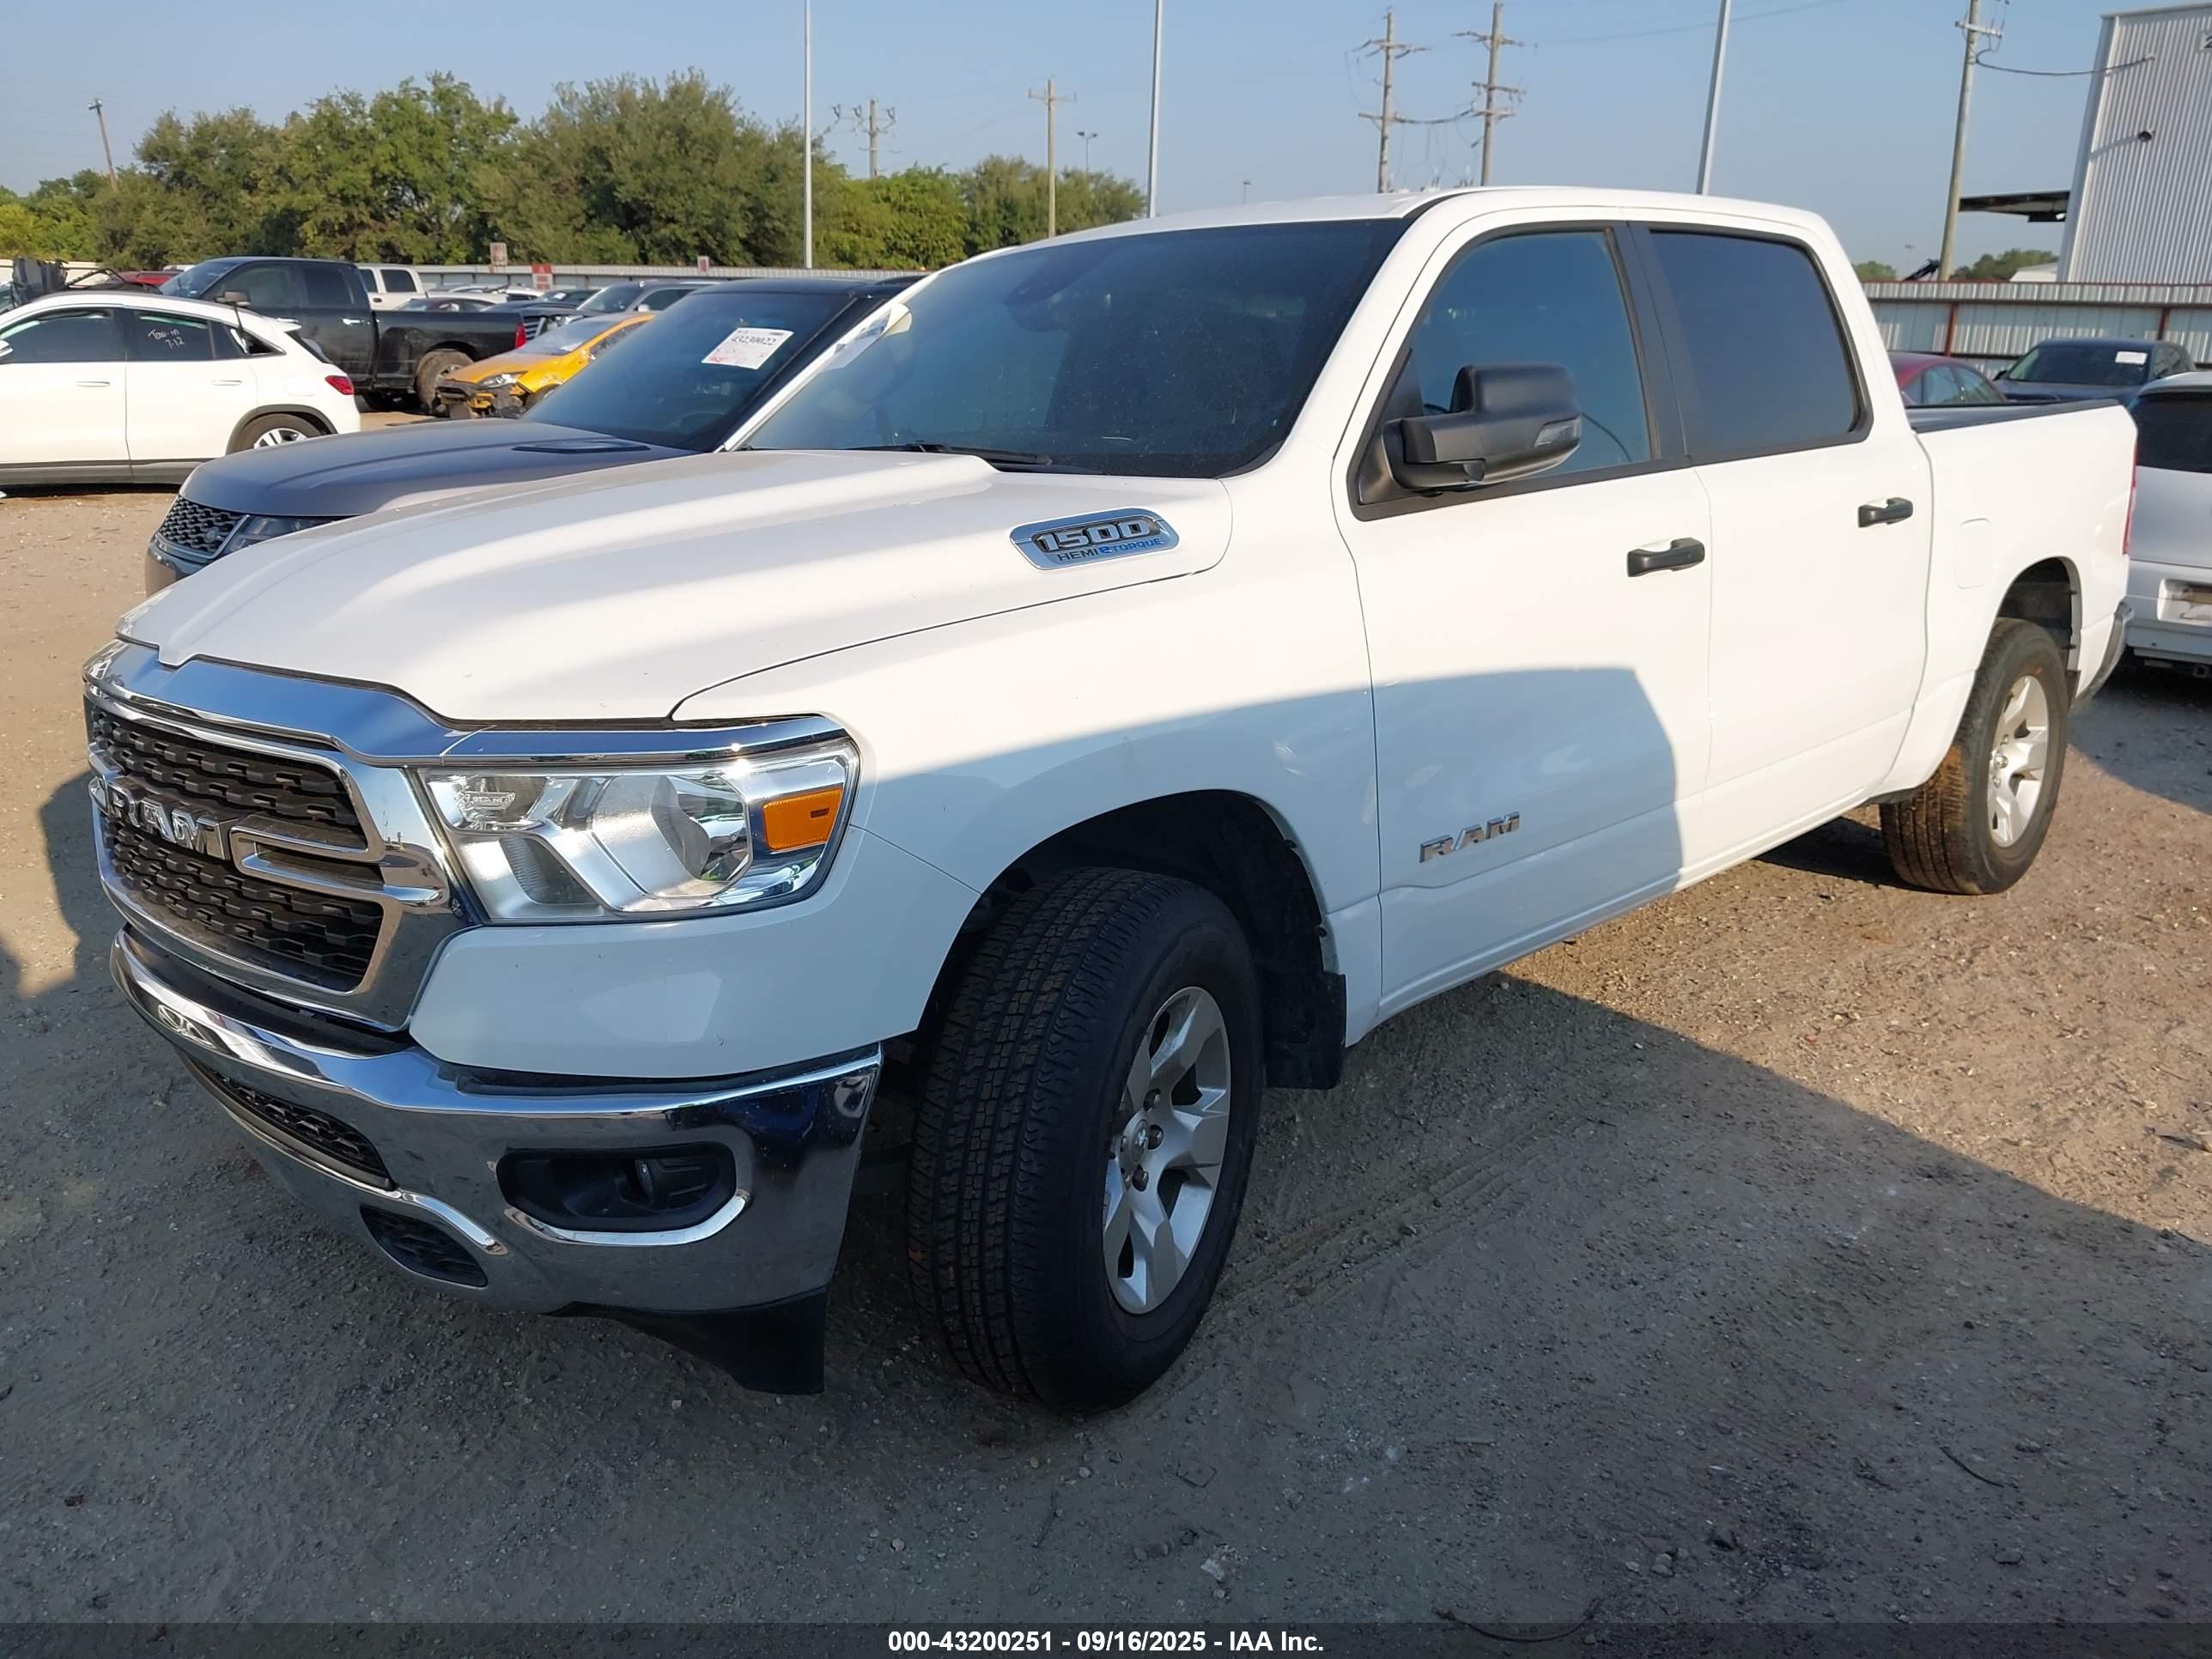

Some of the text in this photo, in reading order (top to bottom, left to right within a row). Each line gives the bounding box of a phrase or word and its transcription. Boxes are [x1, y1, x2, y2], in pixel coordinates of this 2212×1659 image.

[1036, 519, 1151, 552] 1500
[1057, 549, 1098, 562] HEMI
[106, 781, 226, 860] RAM
[1419, 811, 1520, 863] RAM
